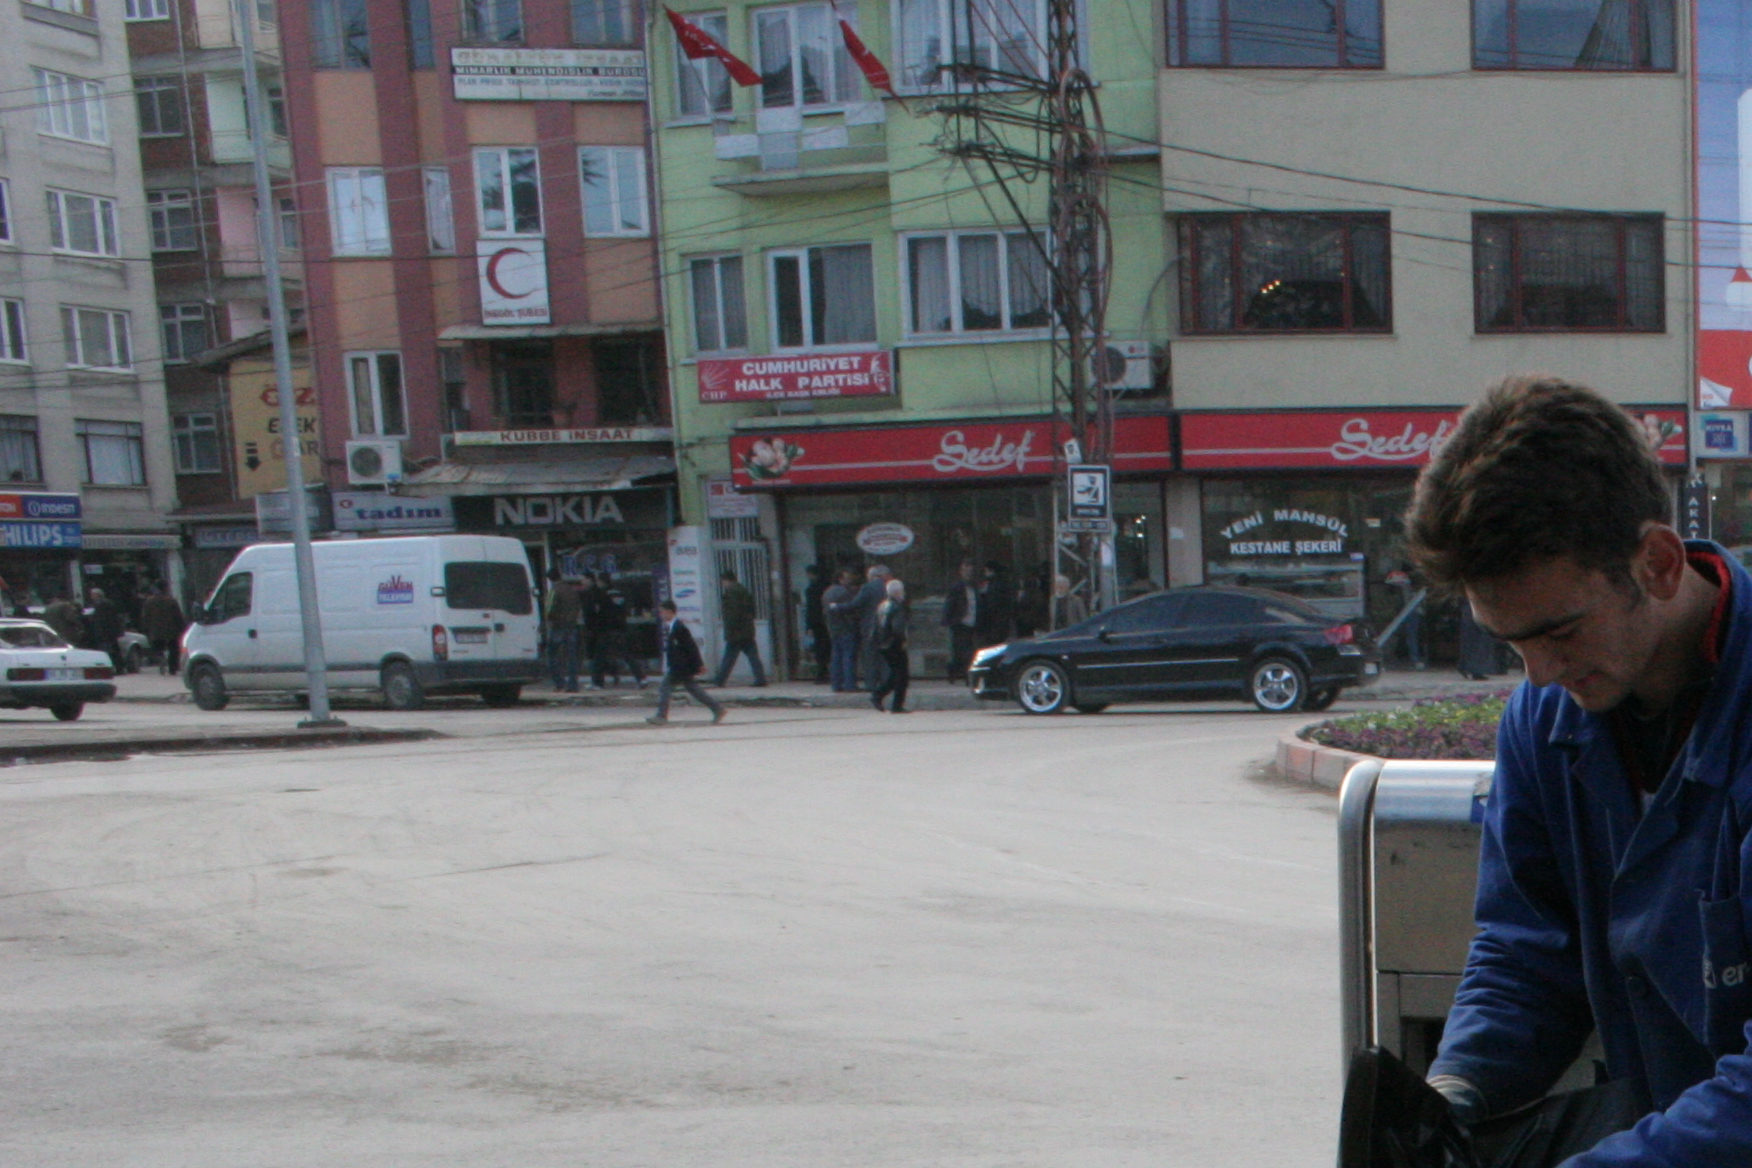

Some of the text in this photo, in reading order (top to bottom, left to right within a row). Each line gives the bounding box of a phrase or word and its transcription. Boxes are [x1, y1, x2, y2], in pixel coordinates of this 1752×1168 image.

[742, 356, 862, 376] CUMHURİYET
[735, 371, 870, 392] HALK PARTİSİ
[933, 430, 1037, 473] Sedef
[356, 505, 443, 519] tadım
[493, 495, 625, 527] NOKIA
[1220, 508, 1350, 540] YENİ MAHSÜL
[1230, 538, 1343, 556] KESTANE ŞEKERİ
